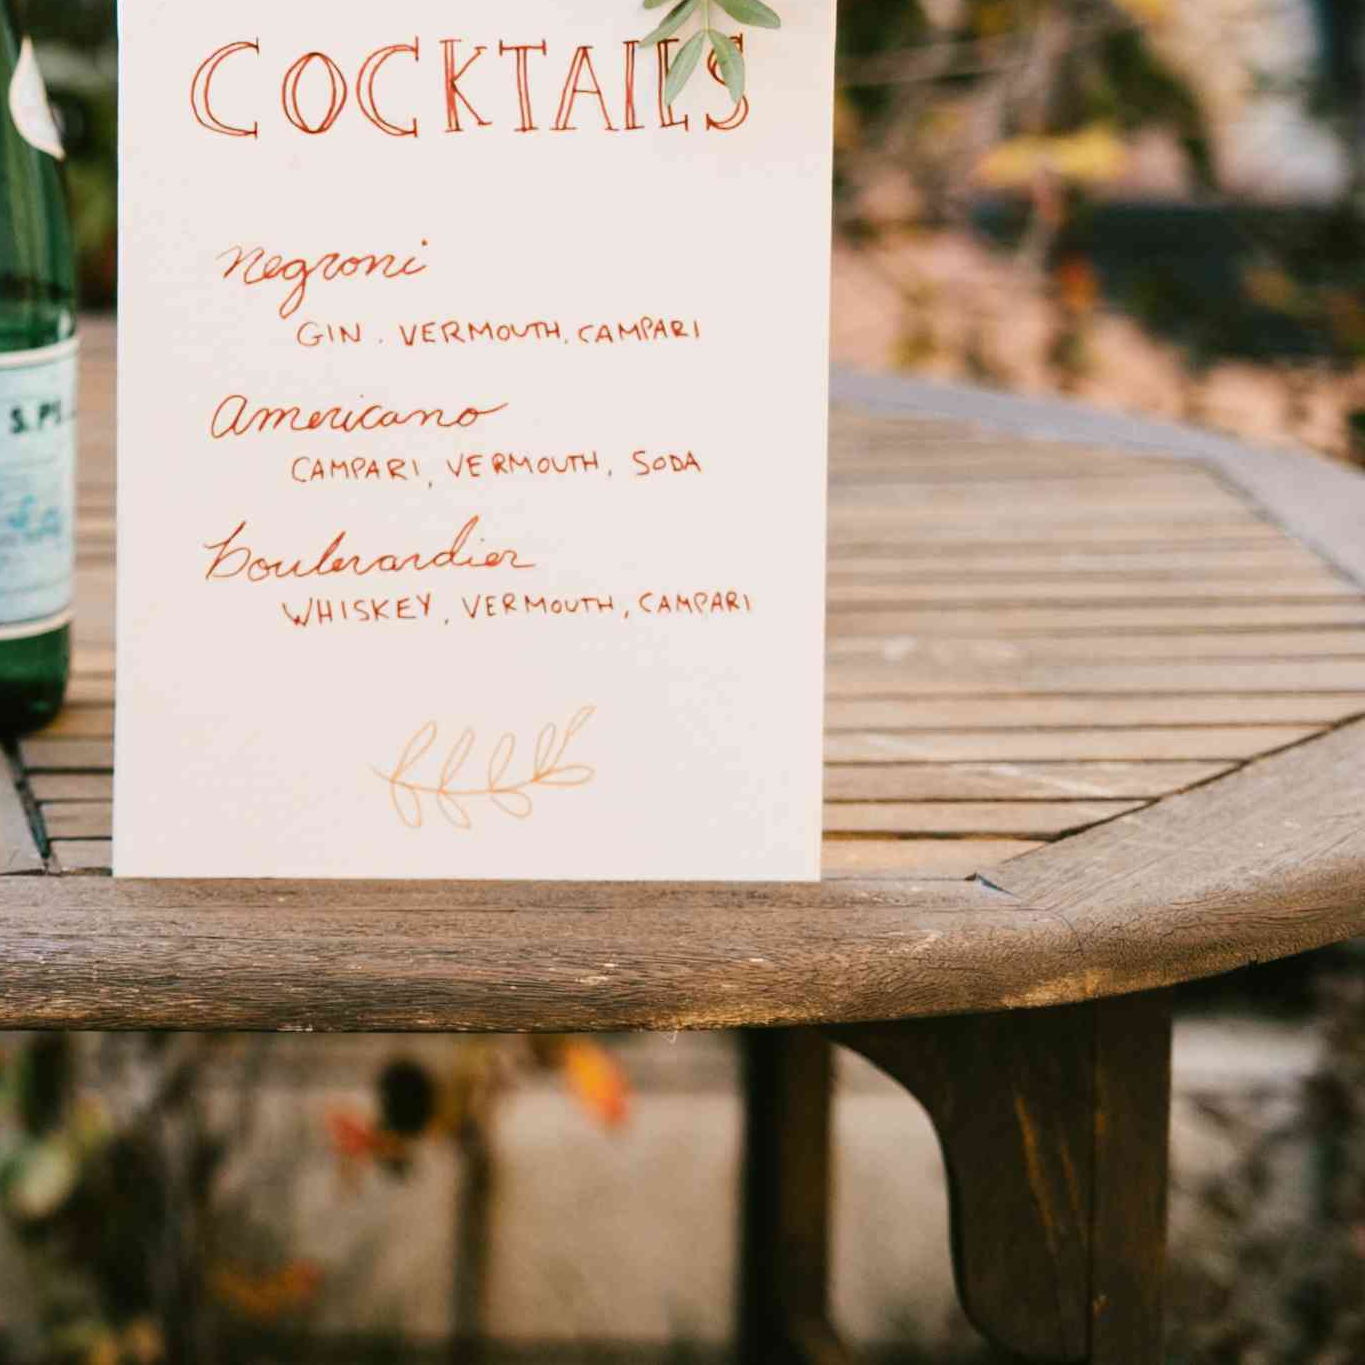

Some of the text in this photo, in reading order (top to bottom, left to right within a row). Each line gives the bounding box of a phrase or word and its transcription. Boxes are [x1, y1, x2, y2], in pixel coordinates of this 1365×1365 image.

[190, 33, 750, 138] COCKTAILS
[577, 316, 702, 344] CAMPARI
[632, 450, 703, 477] SODA
[462, 592, 631, 619] VERMOUTH,
[638, 591, 754, 614] CAMPARI
